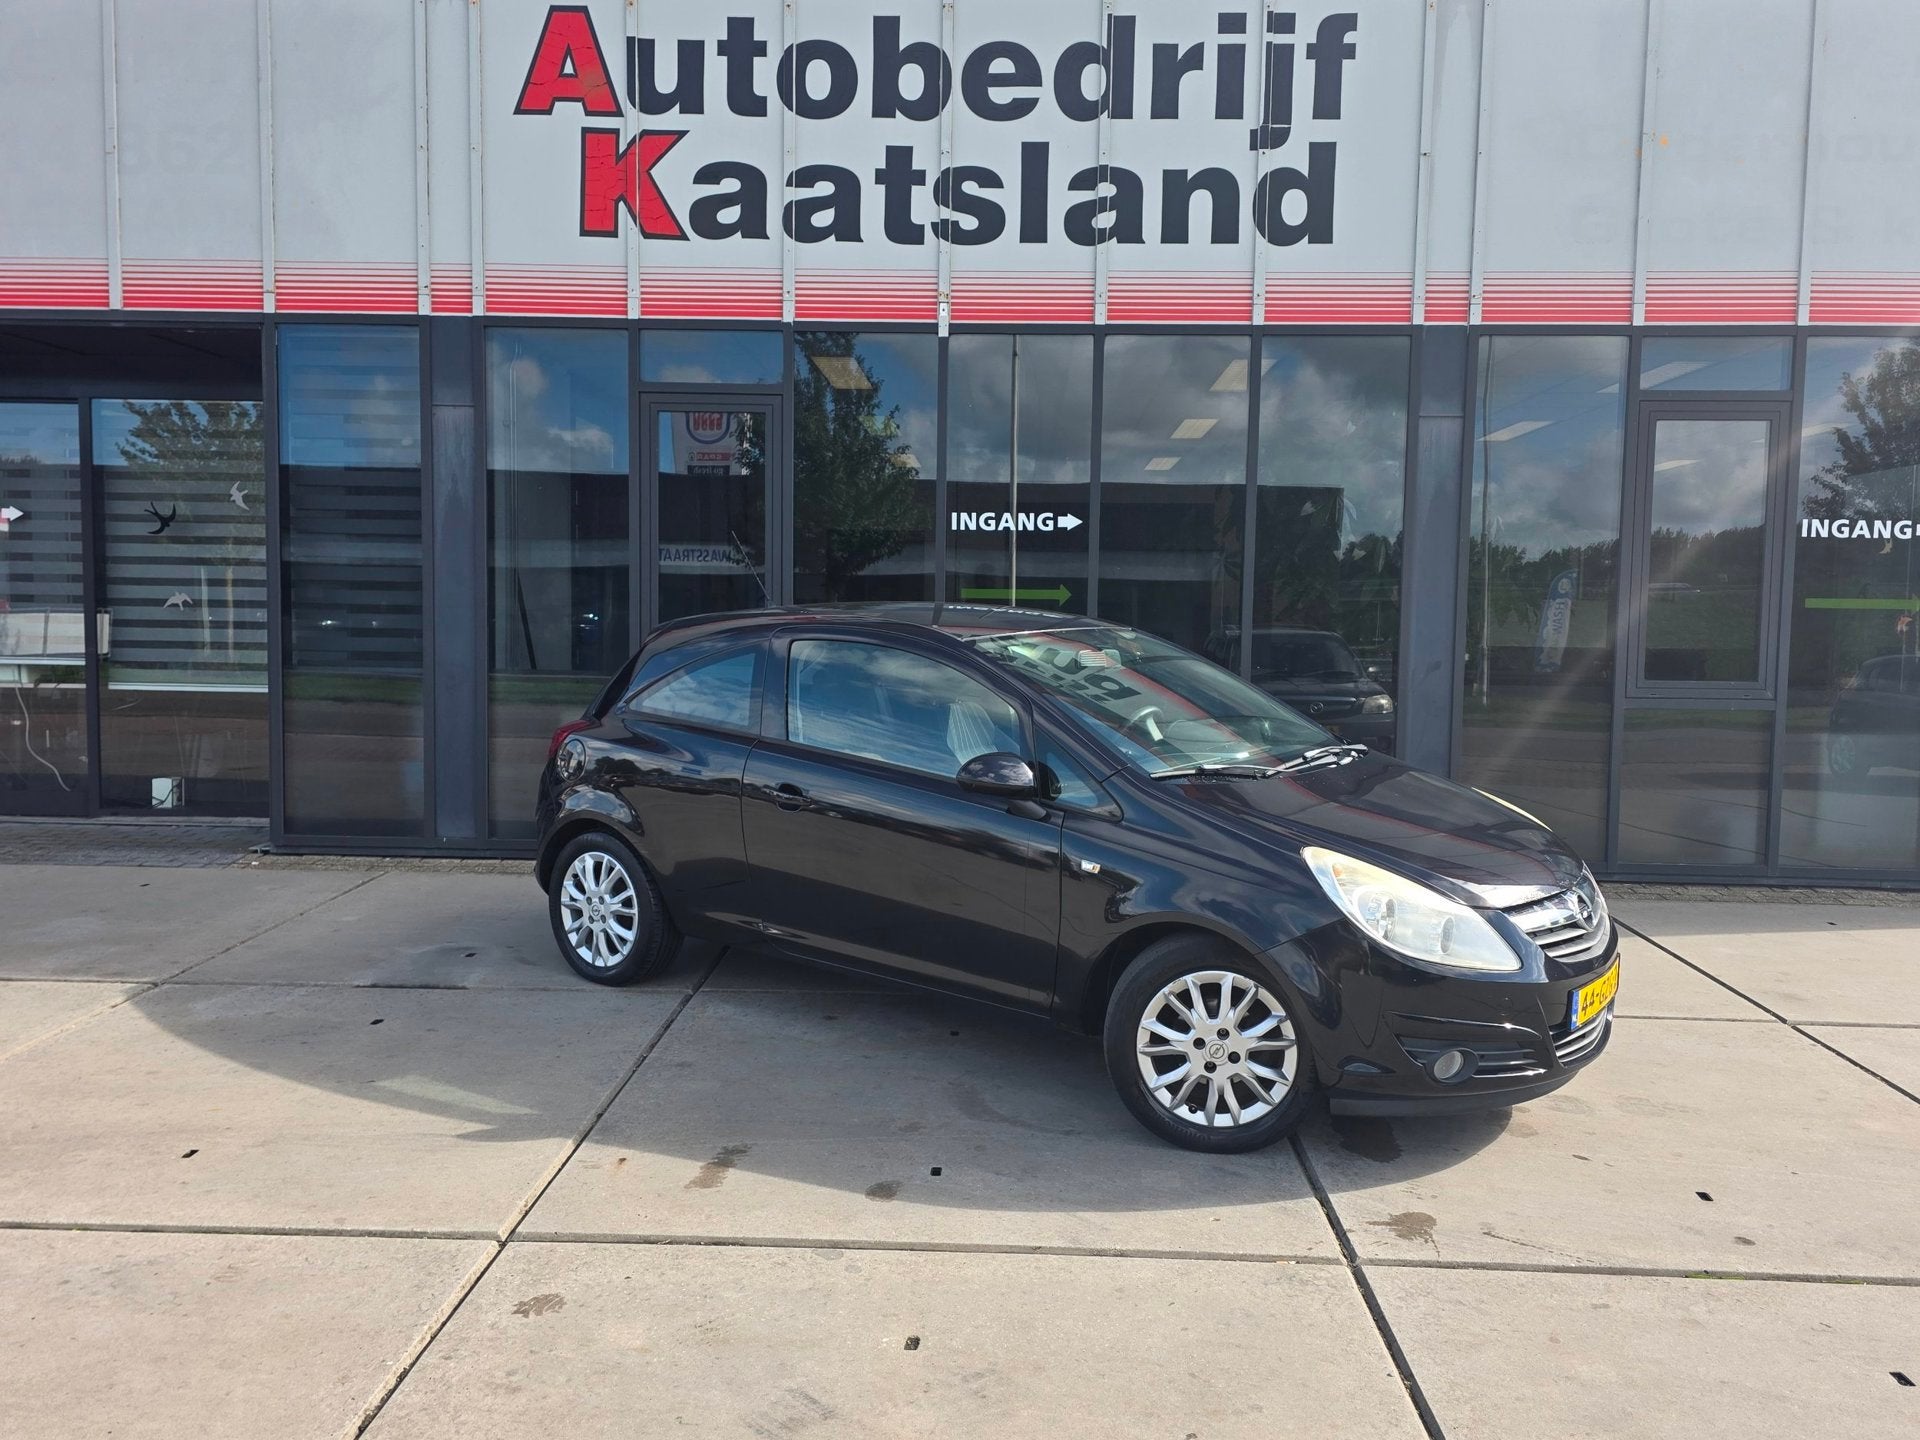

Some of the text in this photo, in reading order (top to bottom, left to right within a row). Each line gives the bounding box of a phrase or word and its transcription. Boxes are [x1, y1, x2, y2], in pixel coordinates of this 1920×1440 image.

[513, 5, 1359, 151] Autobedrijf
[579, 127, 1338, 247] Kaatsland
[951, 512, 1054, 531] INGANG
[1801, 519, 1912, 539] INGANG
